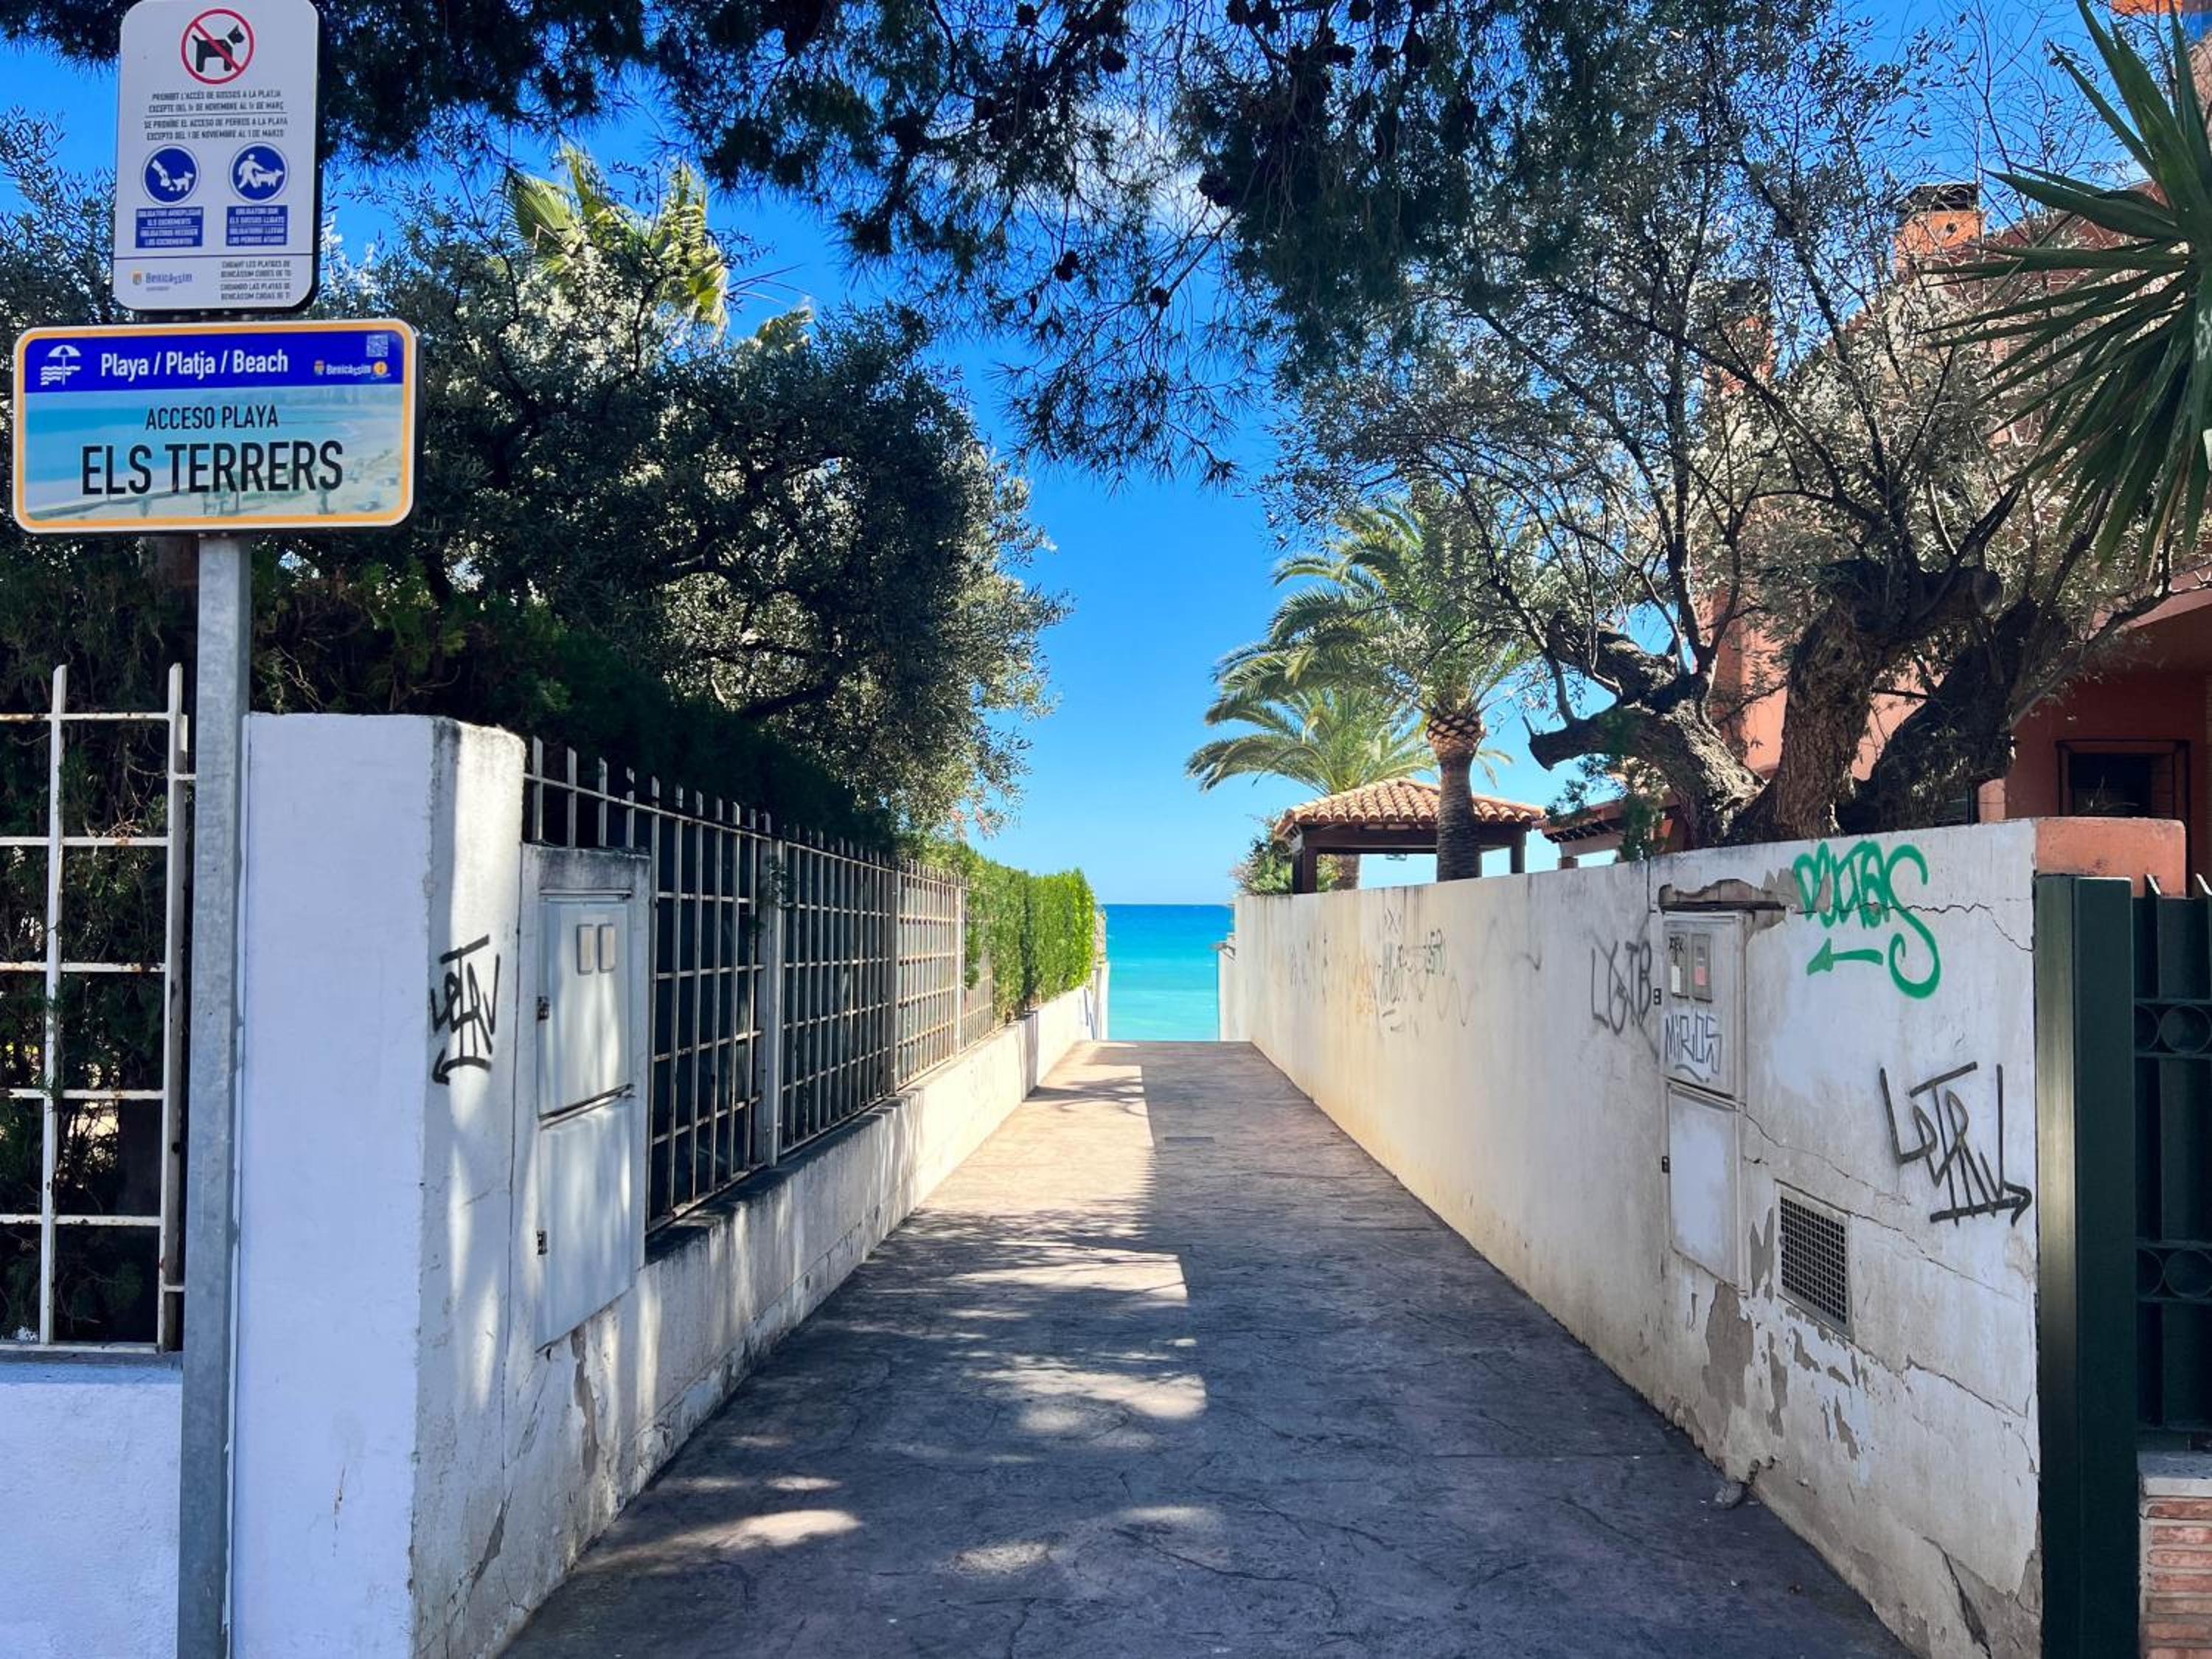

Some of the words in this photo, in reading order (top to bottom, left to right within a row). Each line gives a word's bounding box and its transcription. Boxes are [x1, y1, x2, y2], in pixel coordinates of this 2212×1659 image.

[101, 354, 148, 382] Playa
[166, 351, 215, 380] Platja
[233, 349, 288, 373] Beach
[146, 406, 215, 430] ACCESO
[222, 405, 279, 428] PLAYA
[82, 444, 152, 495] ELS
[165, 440, 343, 494] TERRERS
